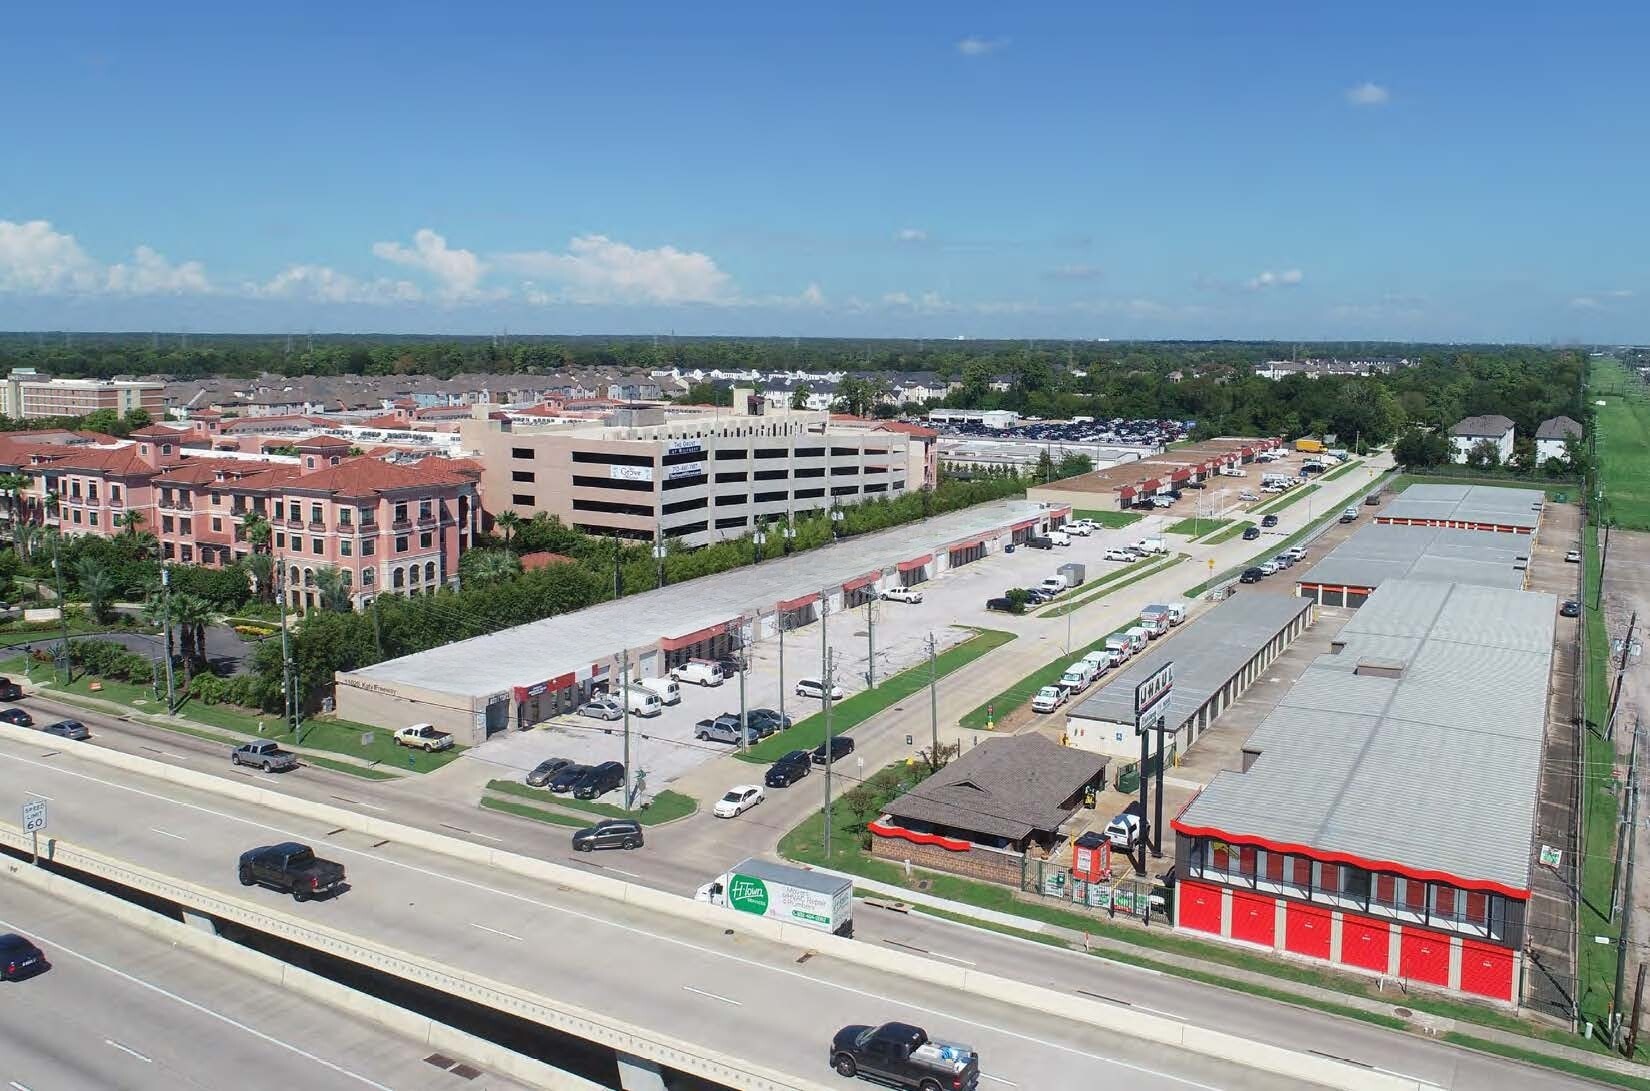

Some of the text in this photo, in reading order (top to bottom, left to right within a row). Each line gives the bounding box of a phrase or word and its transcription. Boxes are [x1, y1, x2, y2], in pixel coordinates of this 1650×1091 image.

[25, 802, 44, 813] SPEED
[26, 810, 42, 820] LIMIT
[27, 818, 43, 830] 60
